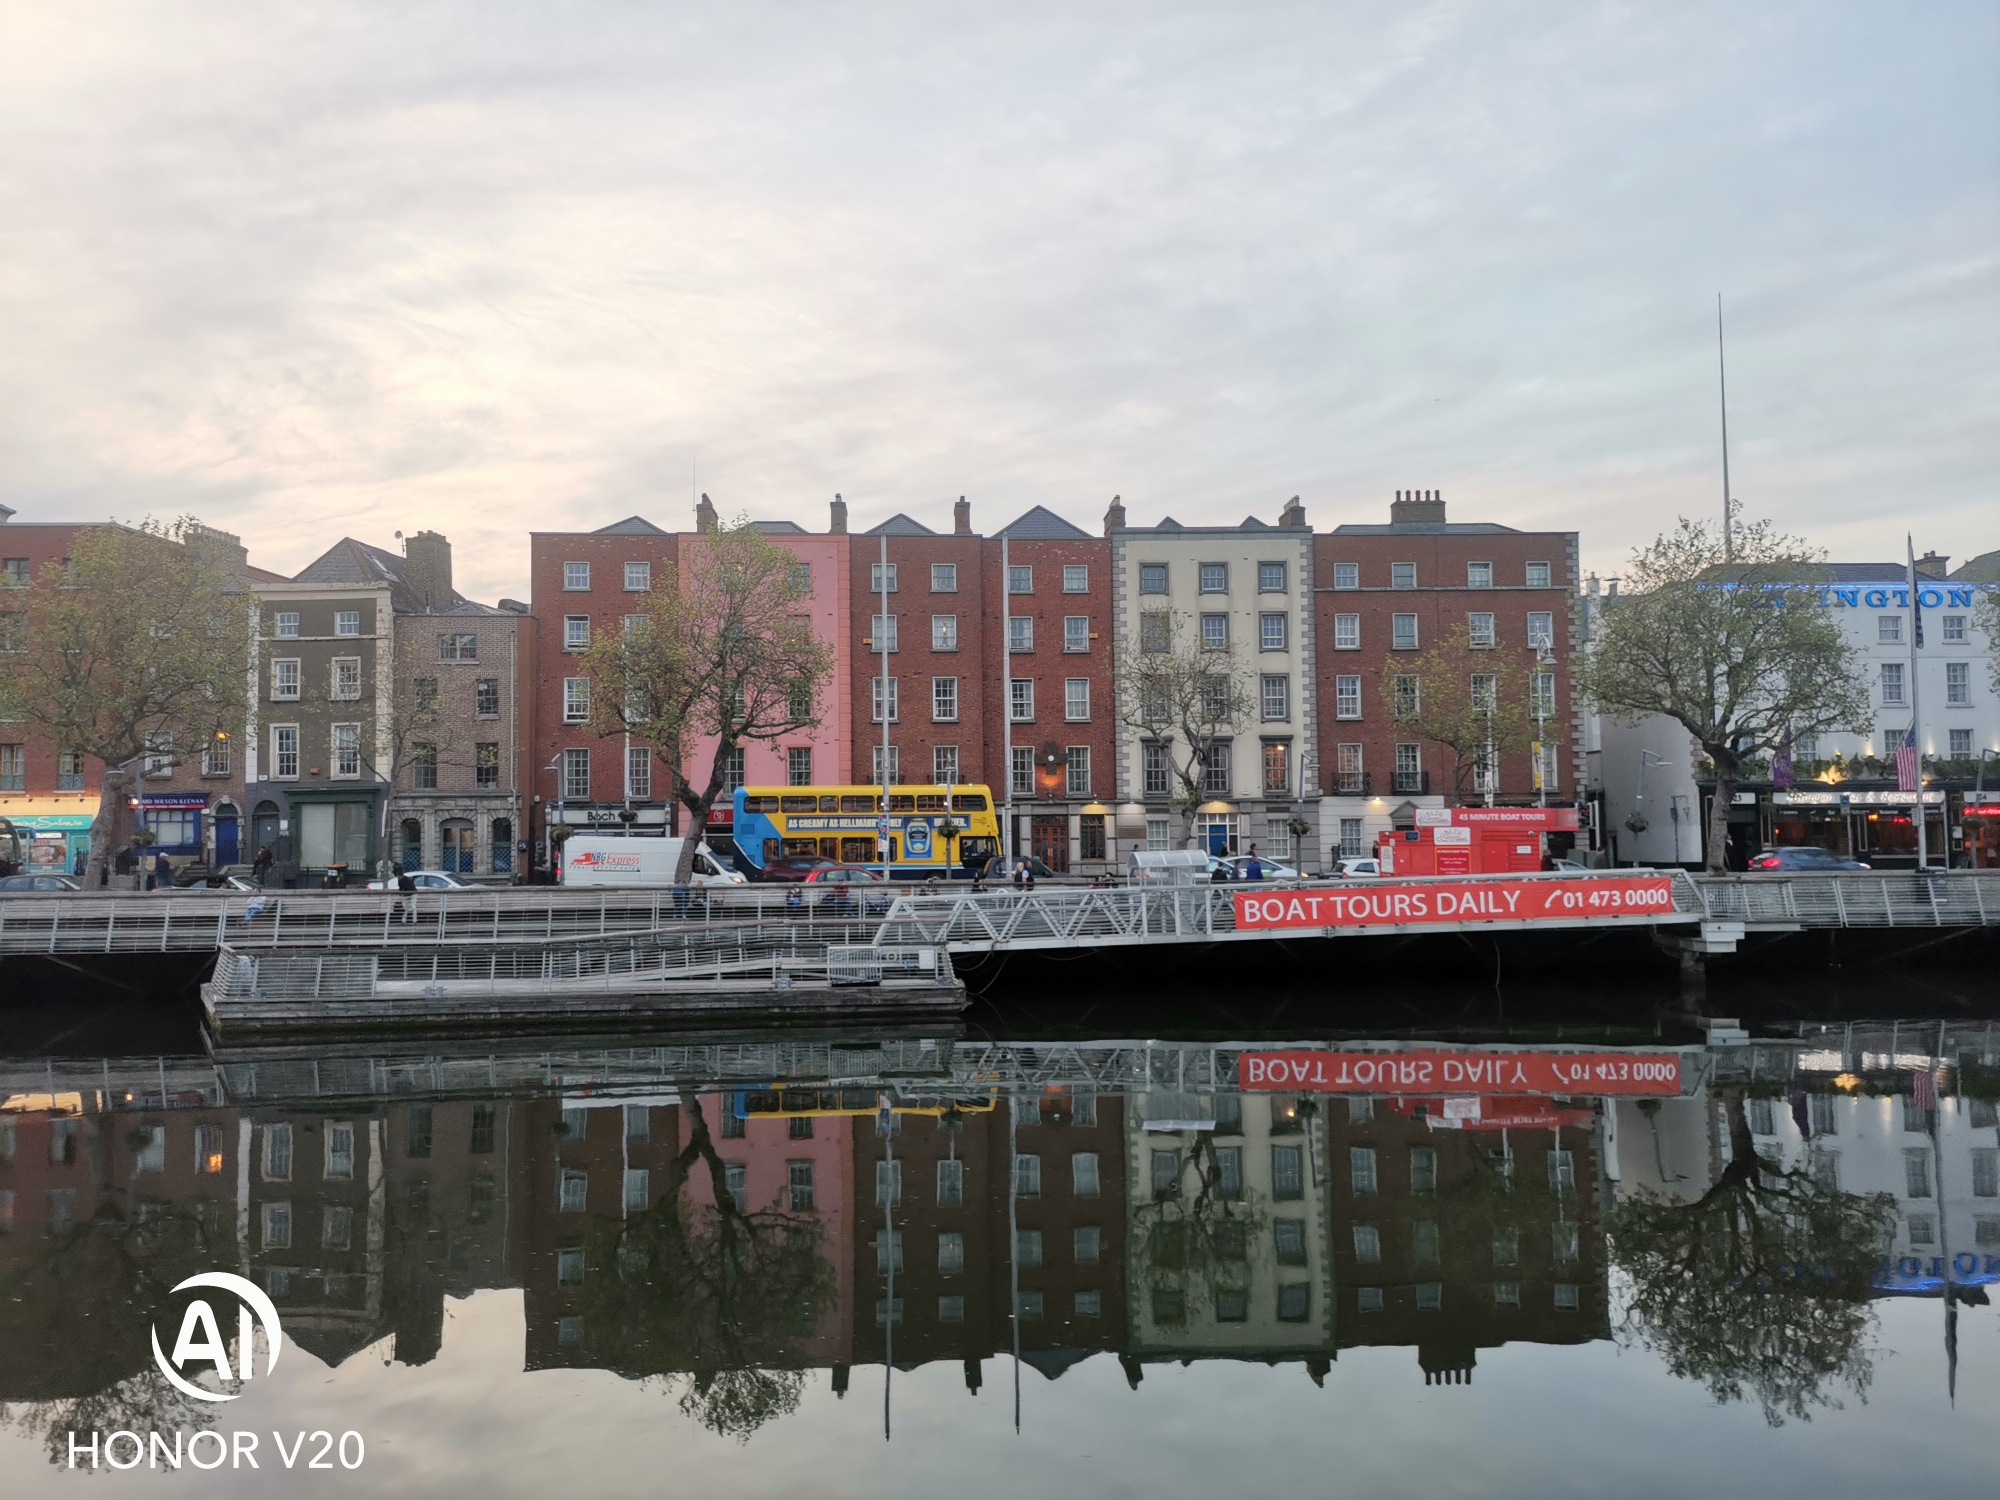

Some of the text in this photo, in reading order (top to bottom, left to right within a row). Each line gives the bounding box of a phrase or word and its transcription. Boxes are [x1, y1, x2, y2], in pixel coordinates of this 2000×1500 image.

[788, 818, 798, 828] AS
[799, 818, 828, 828] CREAMY
[829, 818, 839, 828] AS
[1459, 813, 1468, 821] 45
[1469, 813, 1499, 821] MINUTE
[1500, 813, 1520, 821] BOAT
[1521, 813, 1546, 821] TOURS
[591, 852, 640, 866] NBG Express
[1244, 888, 1668, 923] BOAT TOURS DAILY 01 473 0000
